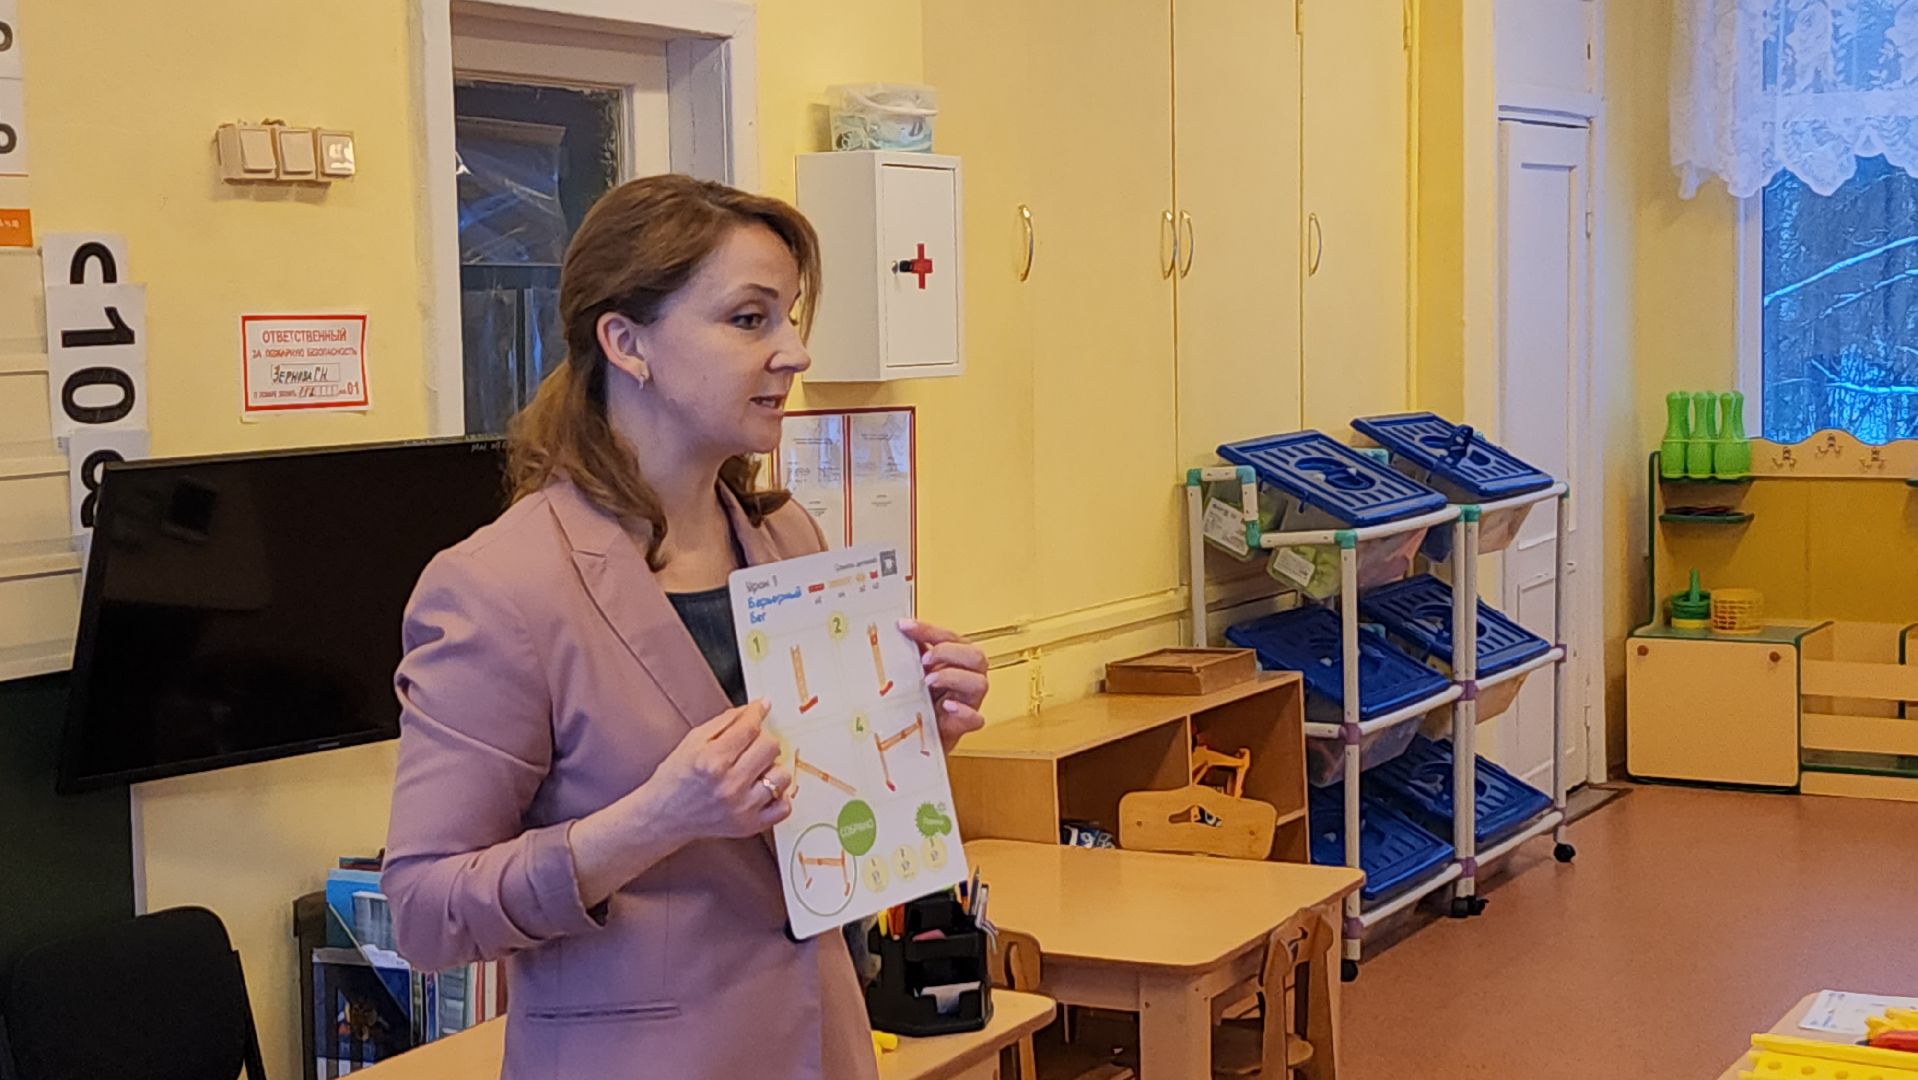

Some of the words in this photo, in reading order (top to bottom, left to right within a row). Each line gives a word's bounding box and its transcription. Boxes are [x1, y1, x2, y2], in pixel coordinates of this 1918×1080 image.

[262, 327, 347, 343] ОТВЕТСТВЕННЫЙ
[745, 580, 770, 594] Урок
[832, 616, 842, 634] 2
[752, 636, 760, 653] 1
